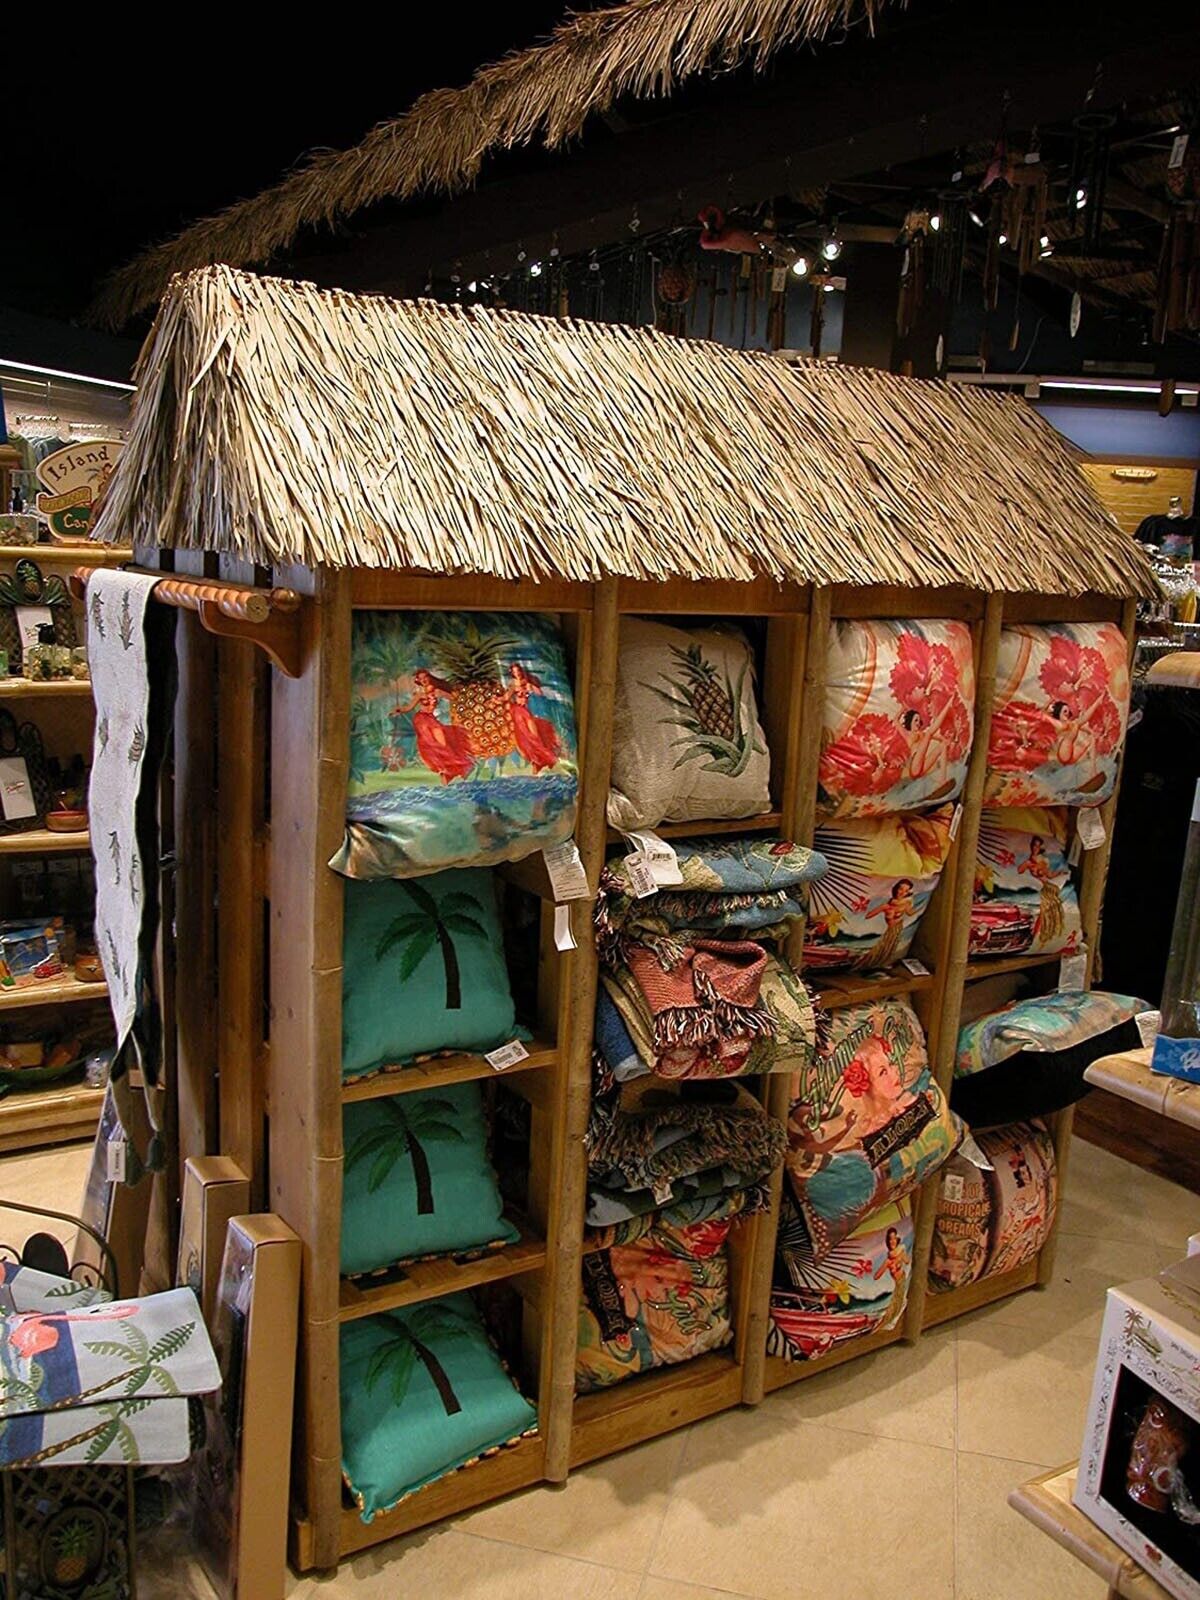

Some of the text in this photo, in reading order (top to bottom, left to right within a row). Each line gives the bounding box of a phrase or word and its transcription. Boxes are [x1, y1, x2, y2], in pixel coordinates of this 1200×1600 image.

[47, 445, 110, 481] Island
[869, 1103, 929, 1163] ALOHA
[938, 1219, 981, 1237] DREAMS
